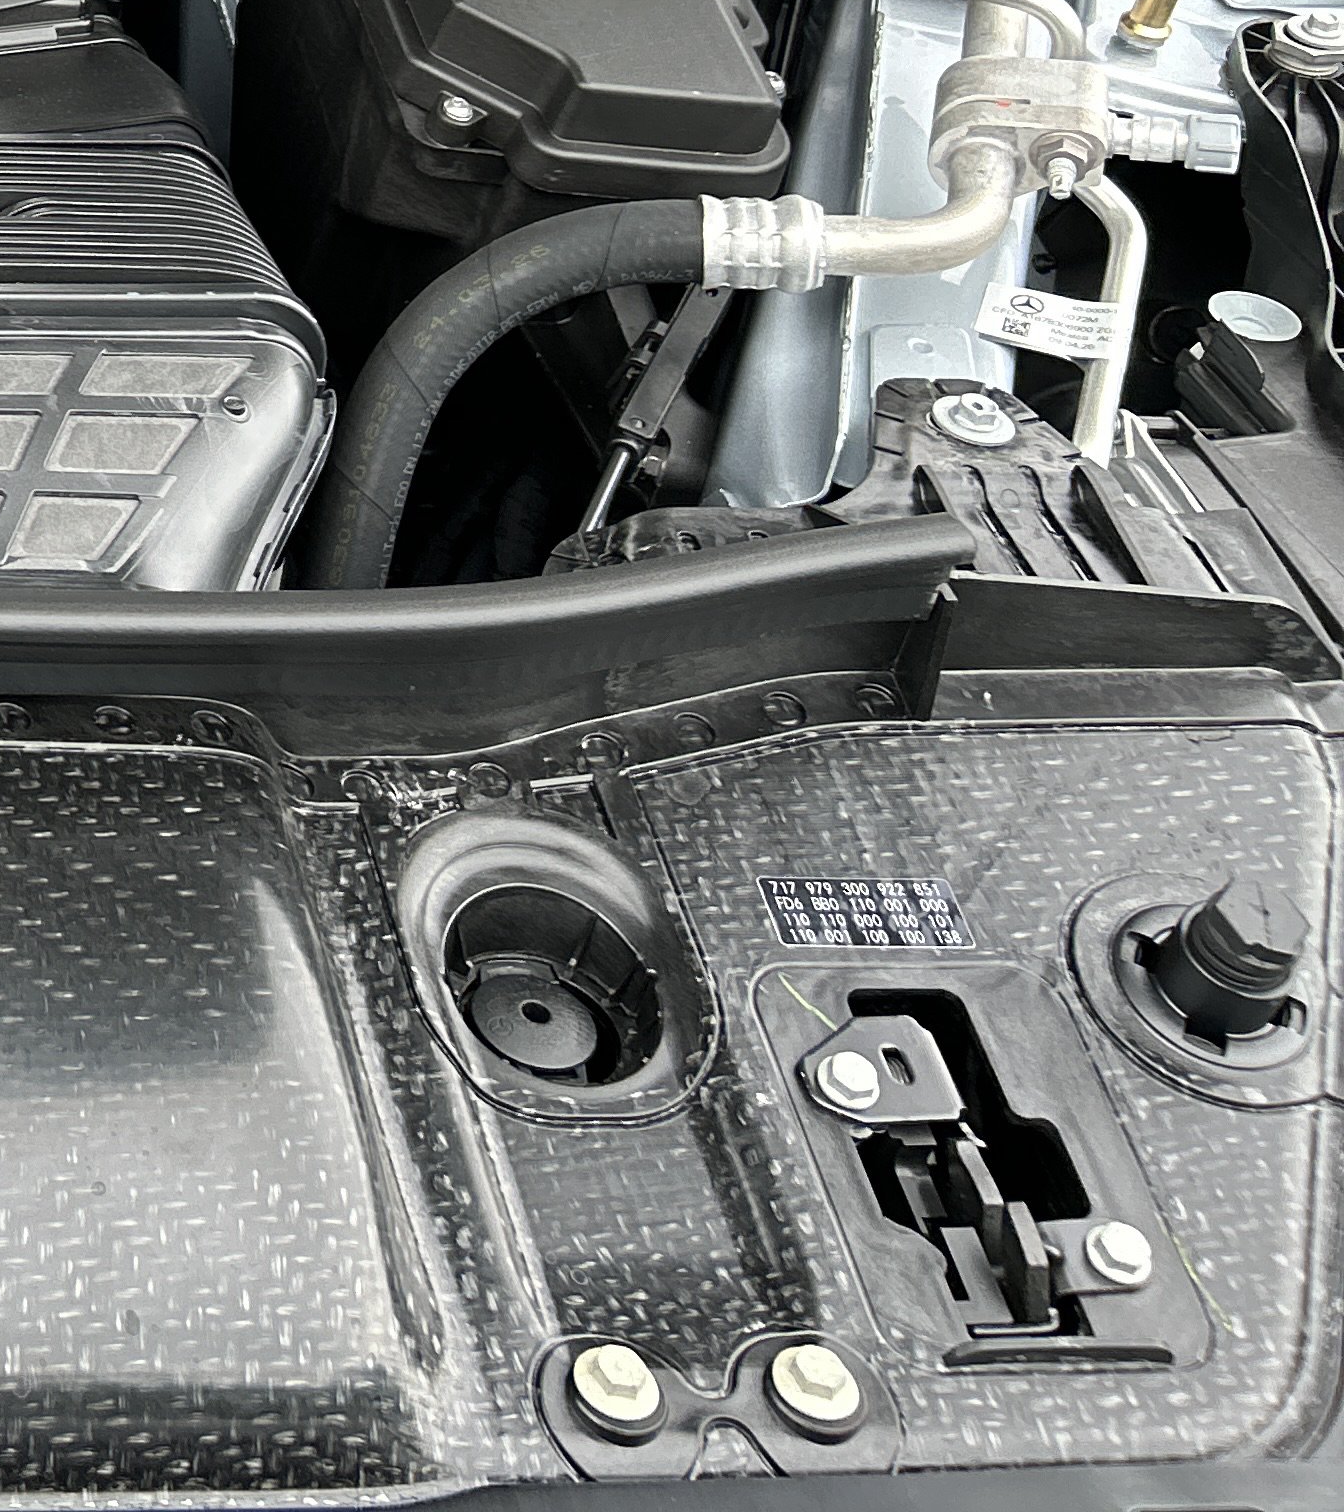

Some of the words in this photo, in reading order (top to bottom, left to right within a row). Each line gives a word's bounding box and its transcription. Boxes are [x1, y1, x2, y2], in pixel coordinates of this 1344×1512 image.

[768, 881, 795, 895] 717
[805, 881, 832, 895] 979
[841, 882, 869, 896] 300
[877, 882, 906, 896] 922
[913, 882, 940, 896] 851
[849, 897, 876, 912] 110
[884, 897, 911, 912] 001
[919, 897, 948, 912] 000
[783, 913, 810, 927] 110
[819, 913, 846, 927] 110
[853, 914, 882, 928] 000
[892, 914, 918, 928] 100
[928, 914, 953, 928] 101
[790, 929, 816, 943] 110
[824, 929, 852, 943] 001
[862, 930, 889, 944] 100
[898, 930, 925, 944] 100
